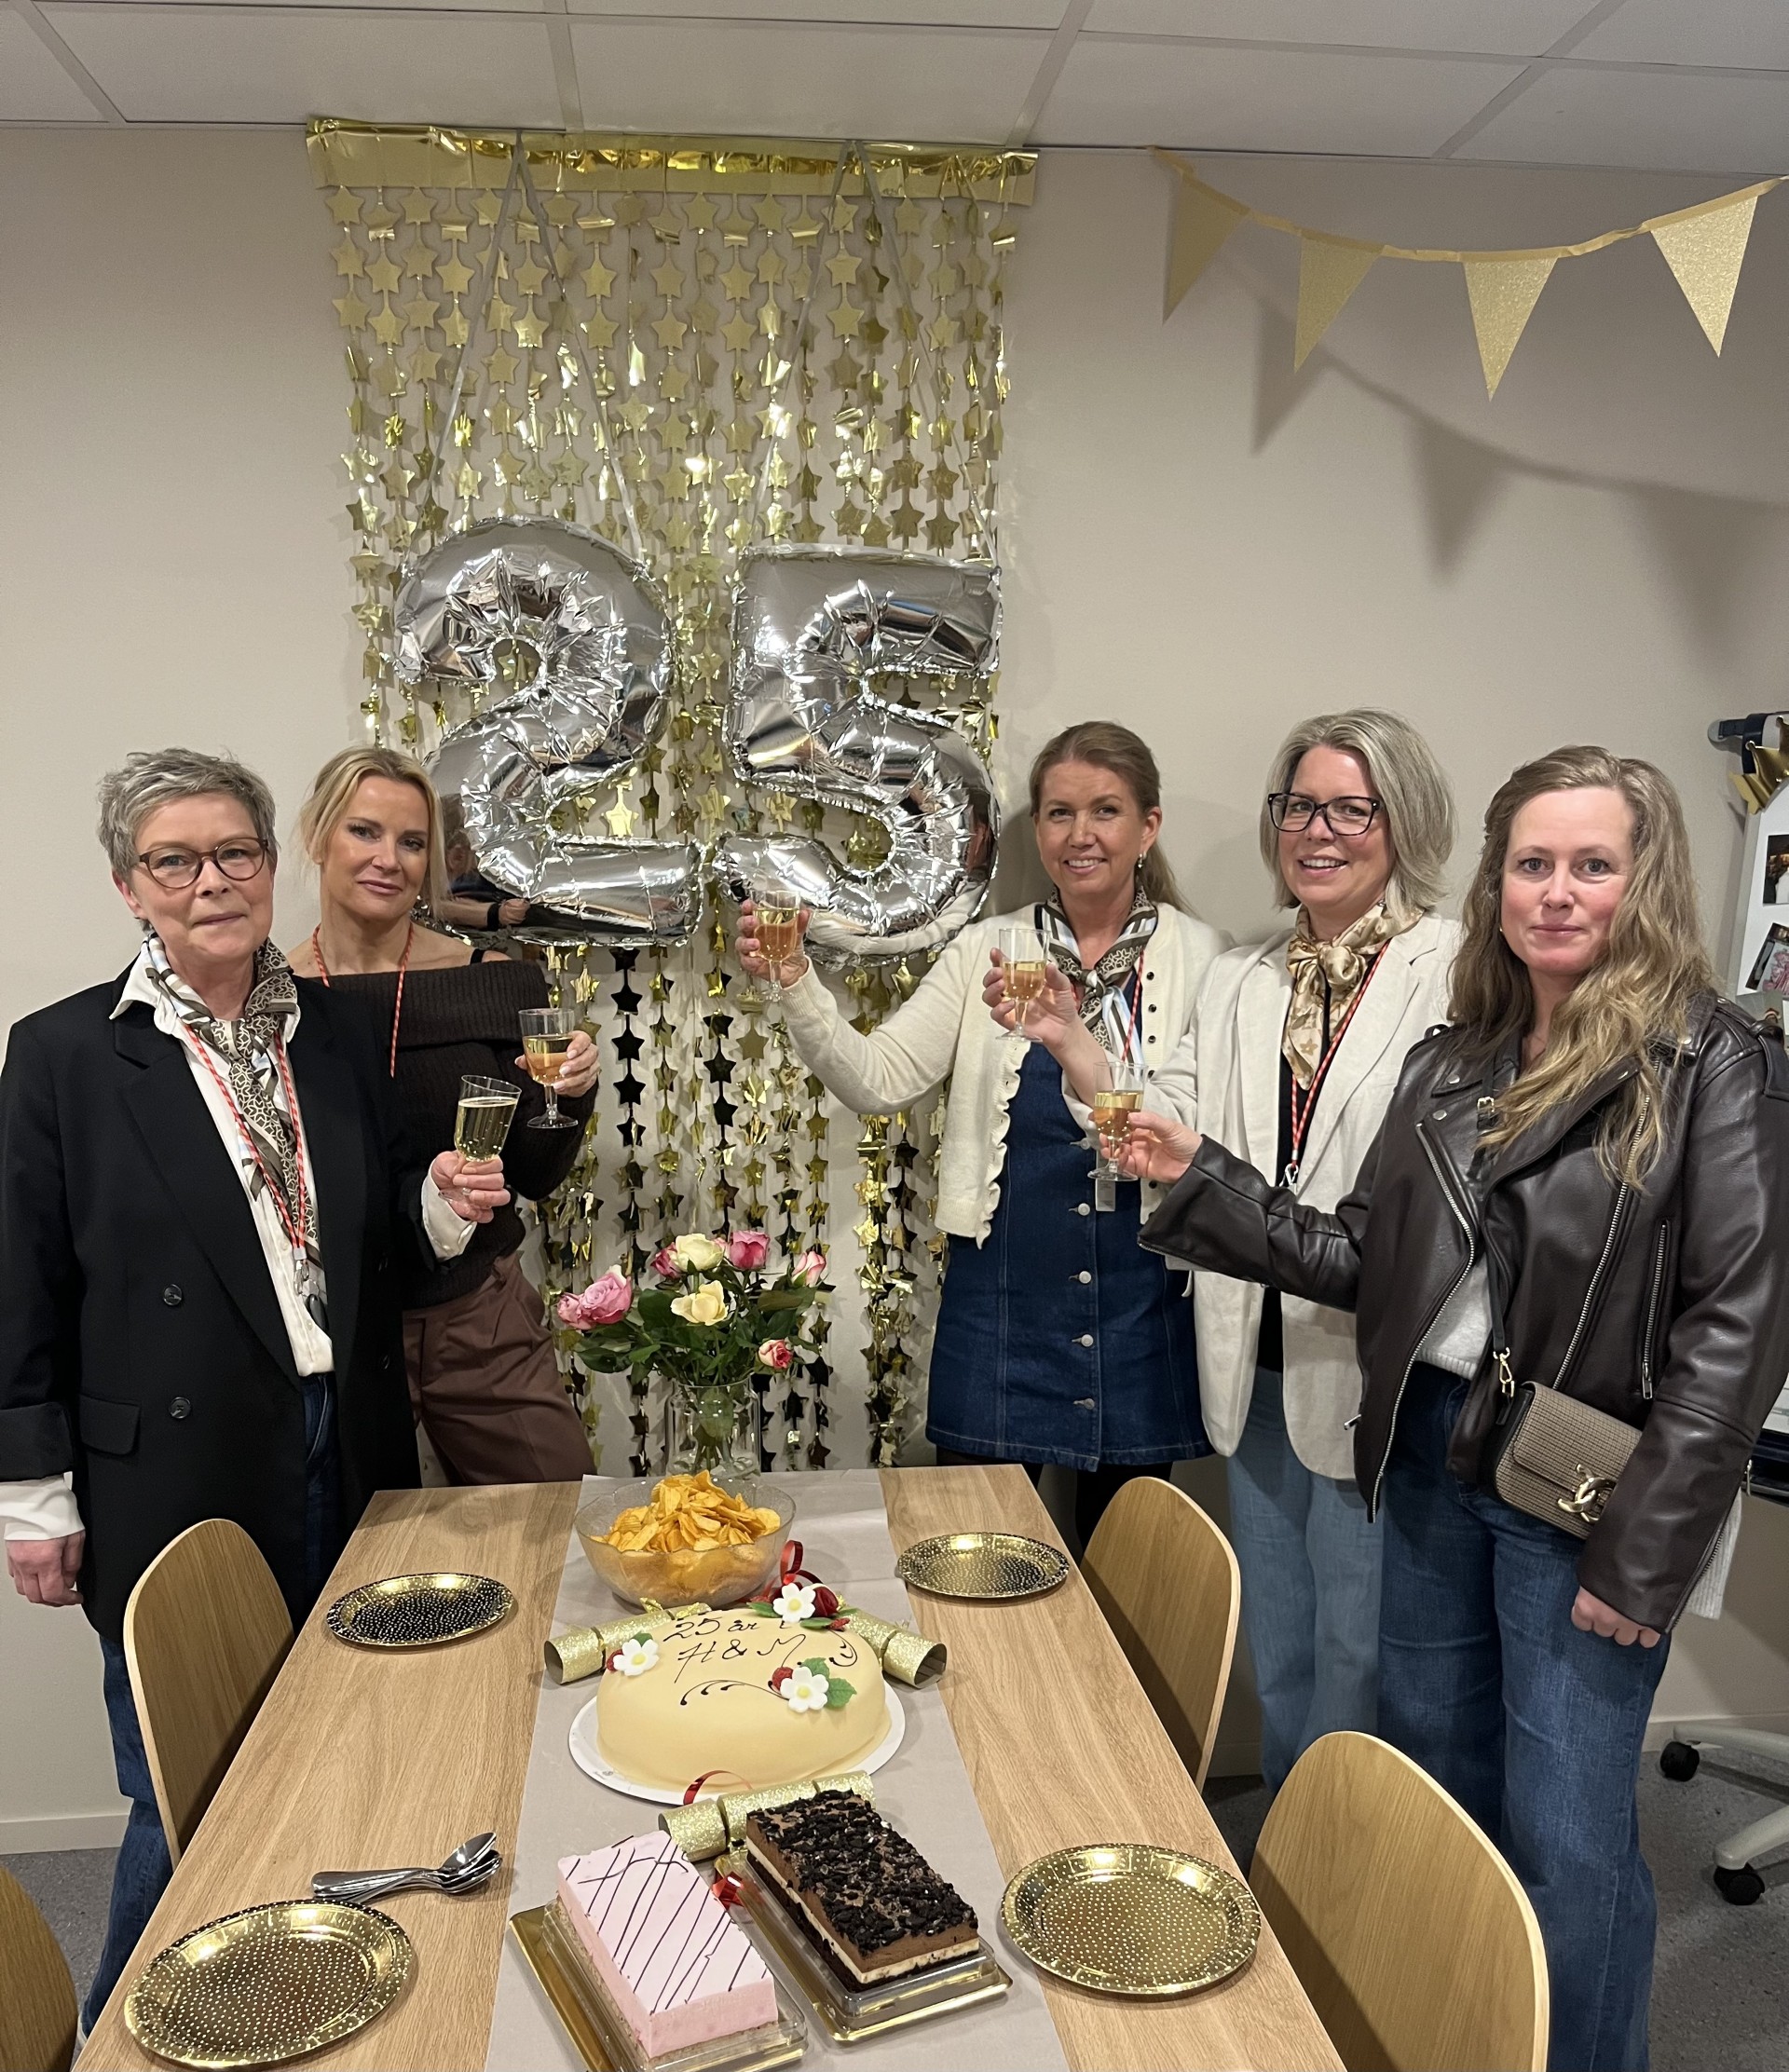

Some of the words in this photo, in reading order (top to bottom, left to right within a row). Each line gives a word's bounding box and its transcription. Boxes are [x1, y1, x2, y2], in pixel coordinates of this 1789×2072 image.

[393, 514, 1004, 967] 25
[662, 1616, 722, 1642] 25
[728, 1619, 761, 1632] år
